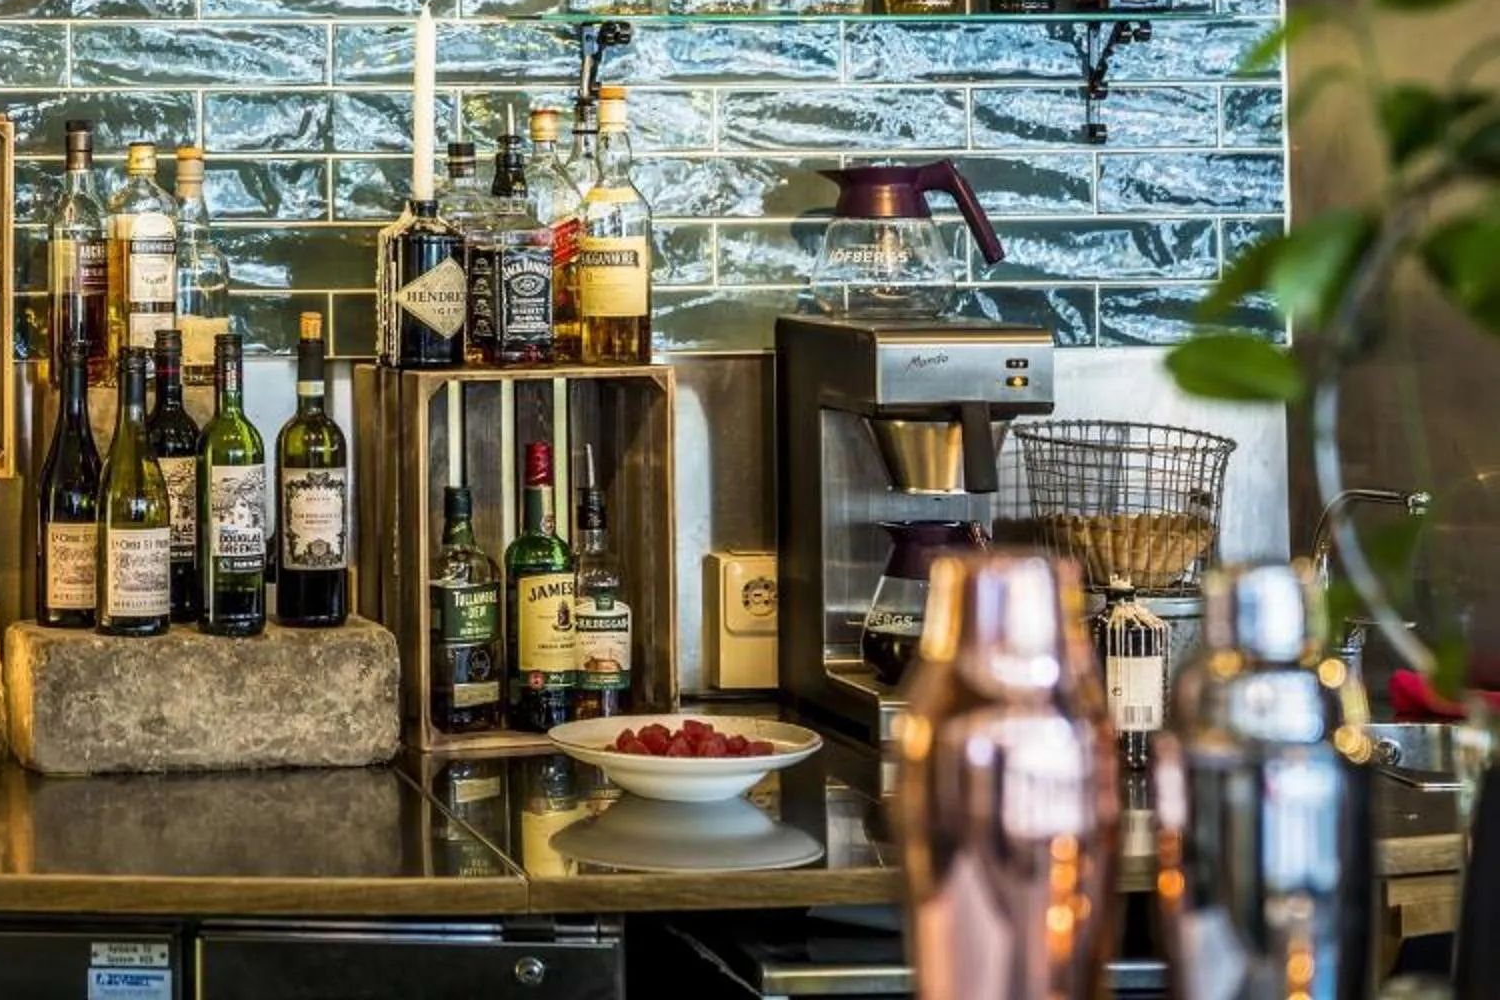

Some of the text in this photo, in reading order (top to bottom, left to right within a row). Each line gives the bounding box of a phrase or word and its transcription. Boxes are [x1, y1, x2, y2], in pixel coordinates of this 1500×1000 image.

[407, 290, 467, 304] HENDRI
[529, 582, 573, 602] JAMES
[869, 613, 913, 629] BERGS
